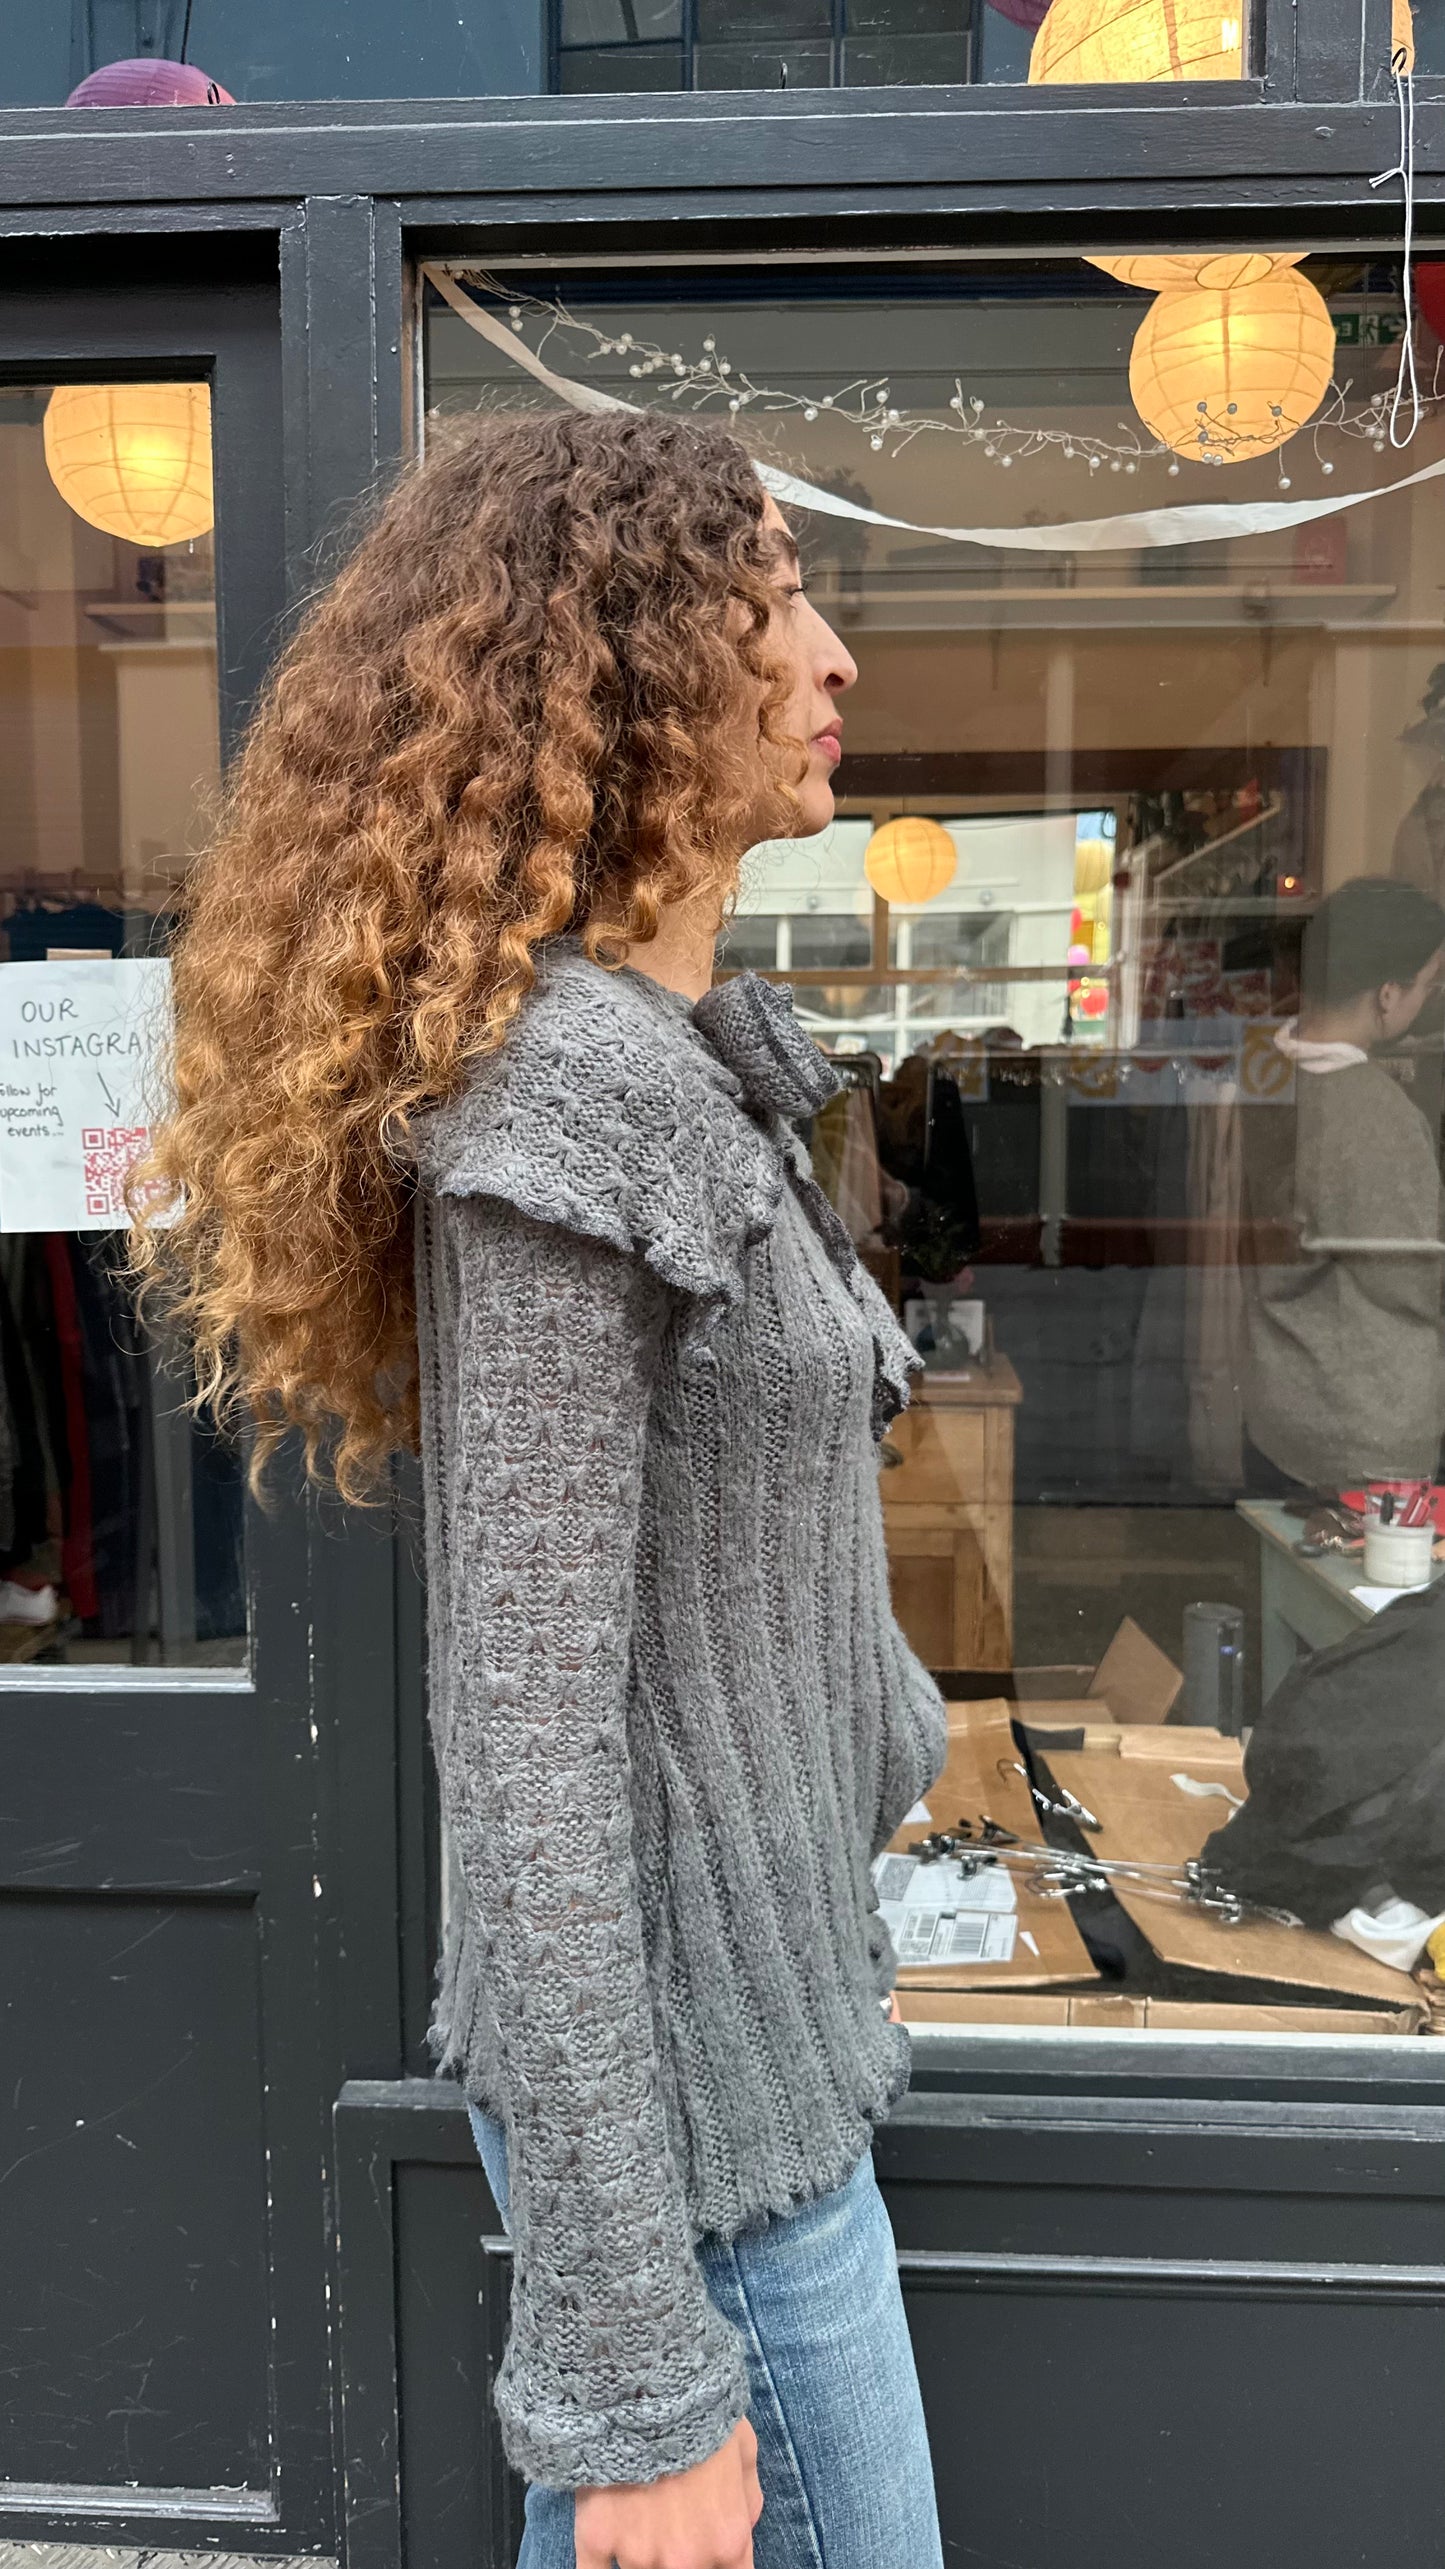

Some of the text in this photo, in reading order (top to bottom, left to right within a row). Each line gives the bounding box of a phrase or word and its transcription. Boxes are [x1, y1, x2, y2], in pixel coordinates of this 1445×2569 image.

[21, 998, 79, 1023] OUR
[0, 1082, 58, 1107] ollow for
[0, 1105, 64, 1127] upcoming
